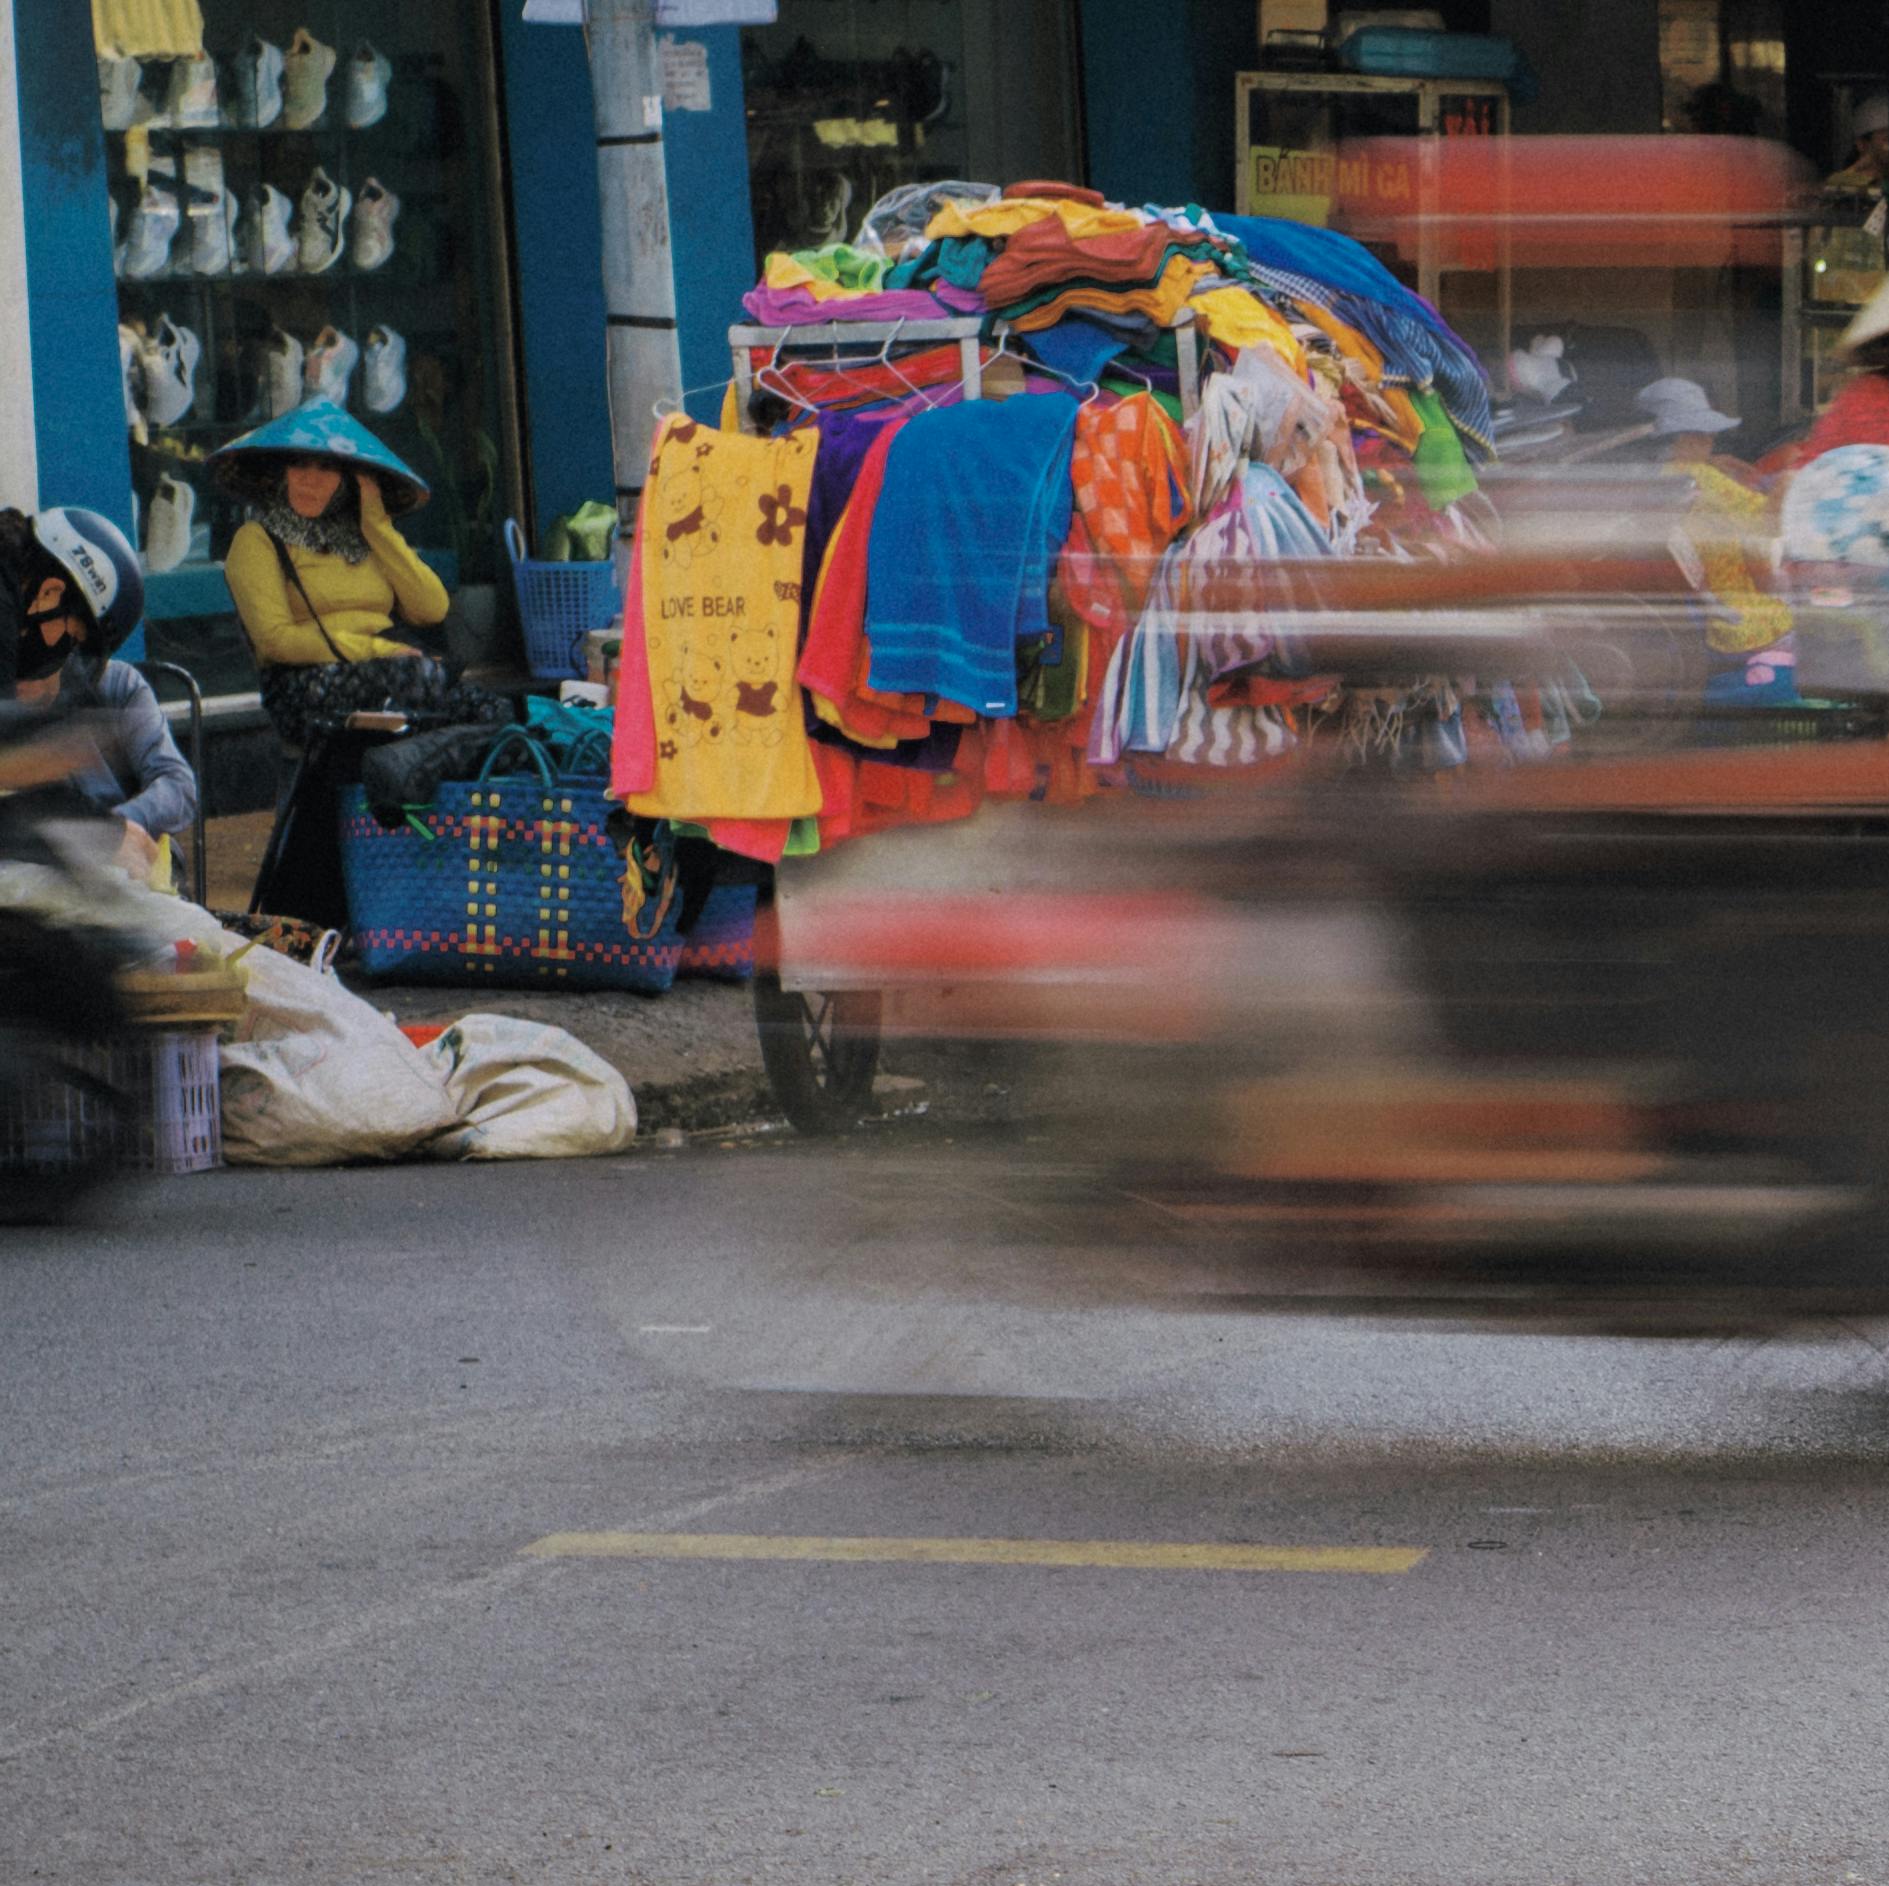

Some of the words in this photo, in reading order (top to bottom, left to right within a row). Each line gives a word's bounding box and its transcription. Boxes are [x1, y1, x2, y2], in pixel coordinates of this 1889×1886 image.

[1256, 146, 1334, 195] BÁNH
[660, 596, 694, 620] LOVE
[702, 596, 747, 618] BEAR
